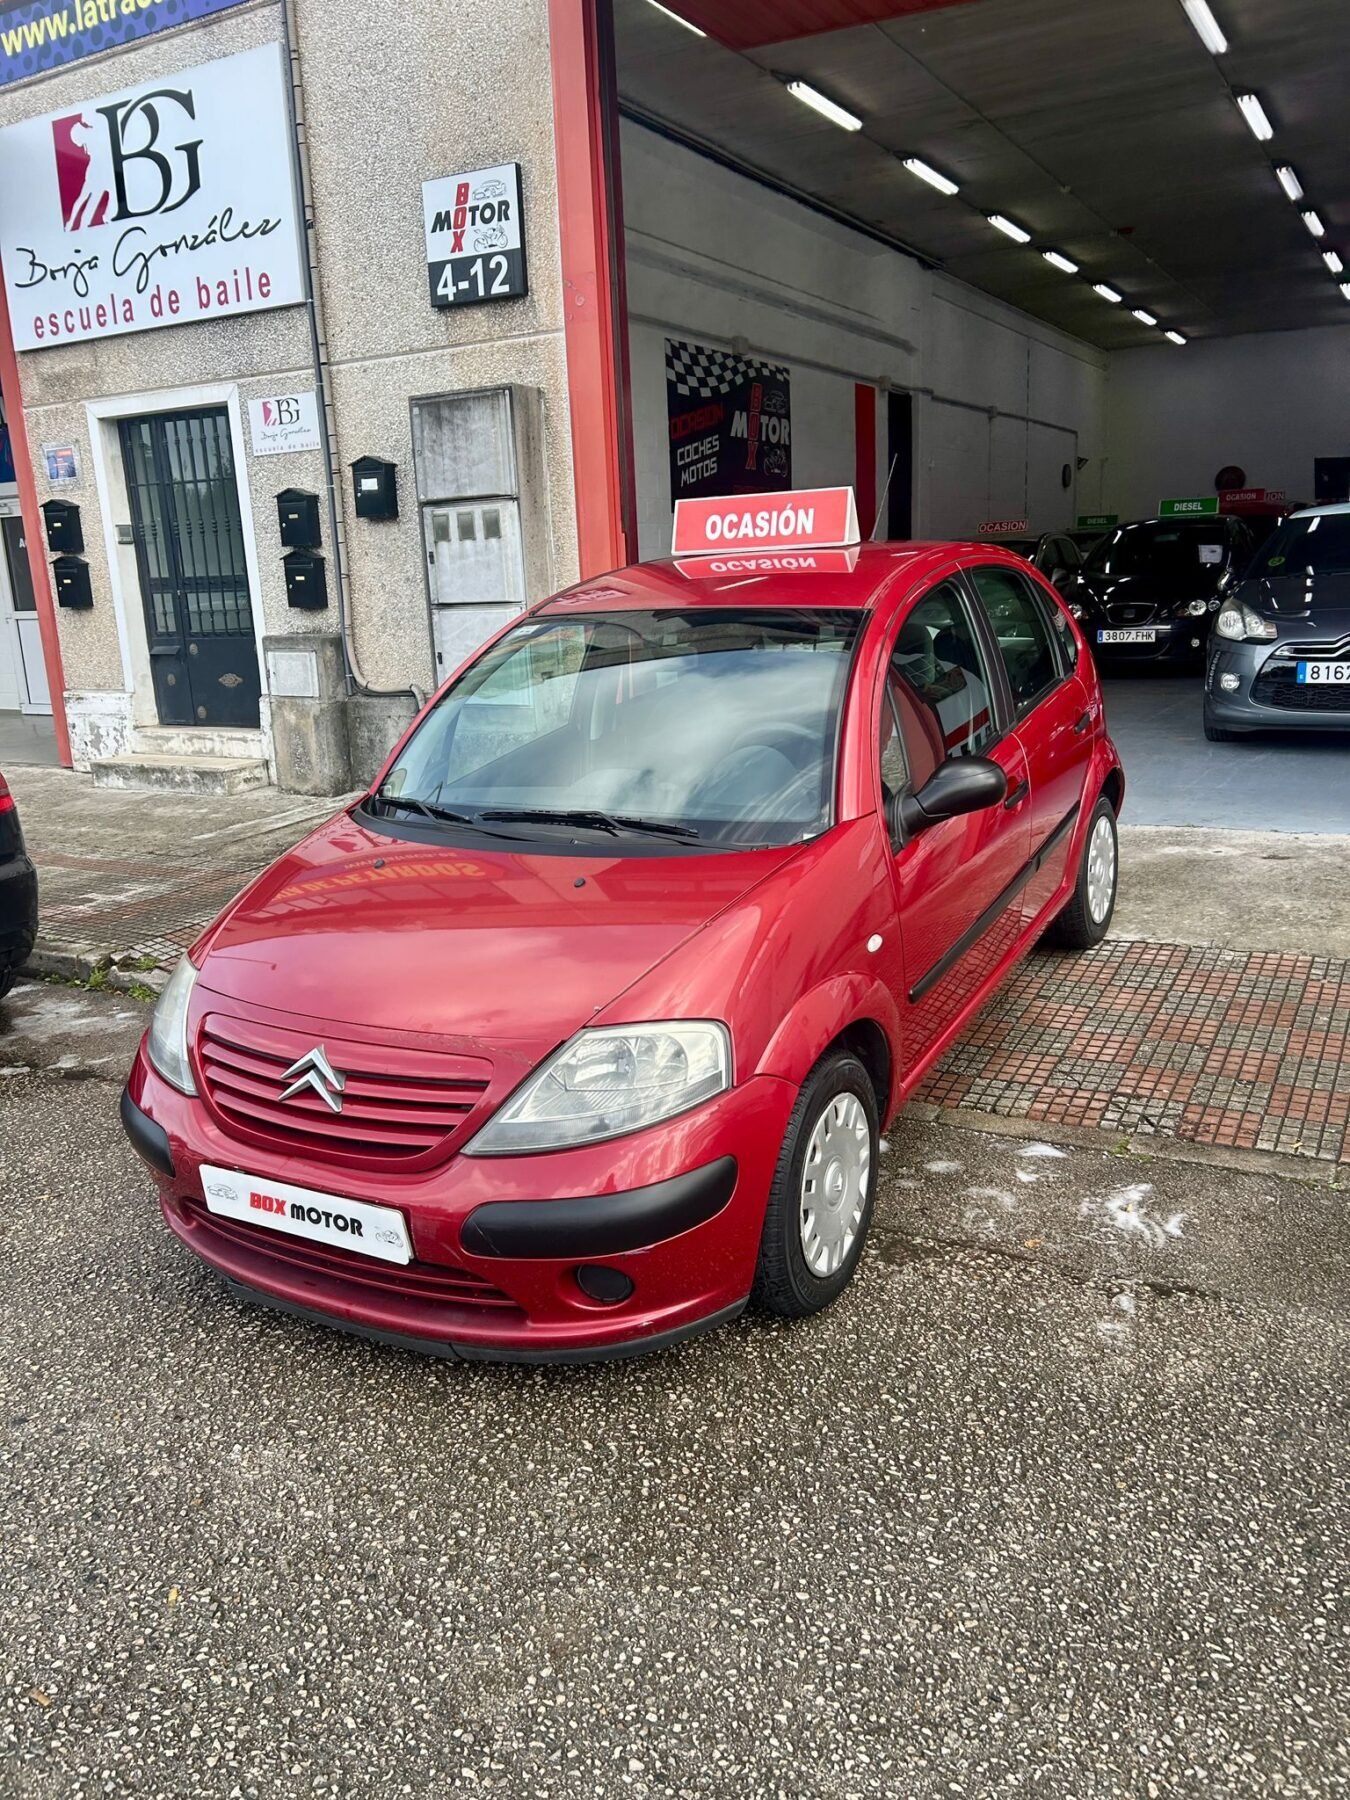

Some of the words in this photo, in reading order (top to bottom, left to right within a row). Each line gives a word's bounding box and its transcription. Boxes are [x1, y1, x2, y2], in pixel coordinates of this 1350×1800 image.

[1, 0, 163, 56] www.latra
[96, 88, 203, 222] BG
[430, 199, 511, 234] MOTOR
[450, 182, 470, 254] BOX
[15, 247, 99, 298] Borja
[112, 206, 282, 294] González
[436, 254, 510, 301] 4-12
[33, 293, 135, 339] escuela
[149, 284, 181, 318] de
[196, 267, 272, 309] baile
[275, 397, 300, 426] BG
[677, 434, 720, 466] COCHES
[680, 457, 718, 488] MOTOS
[704, 503, 815, 541] OCASIÓN
[978, 521, 1026, 533] OCASION
[1173, 502, 1203, 512] DIESEL
[249, 1191, 287, 1217] BOX
[290, 1203, 364, 1238] MOTOR
